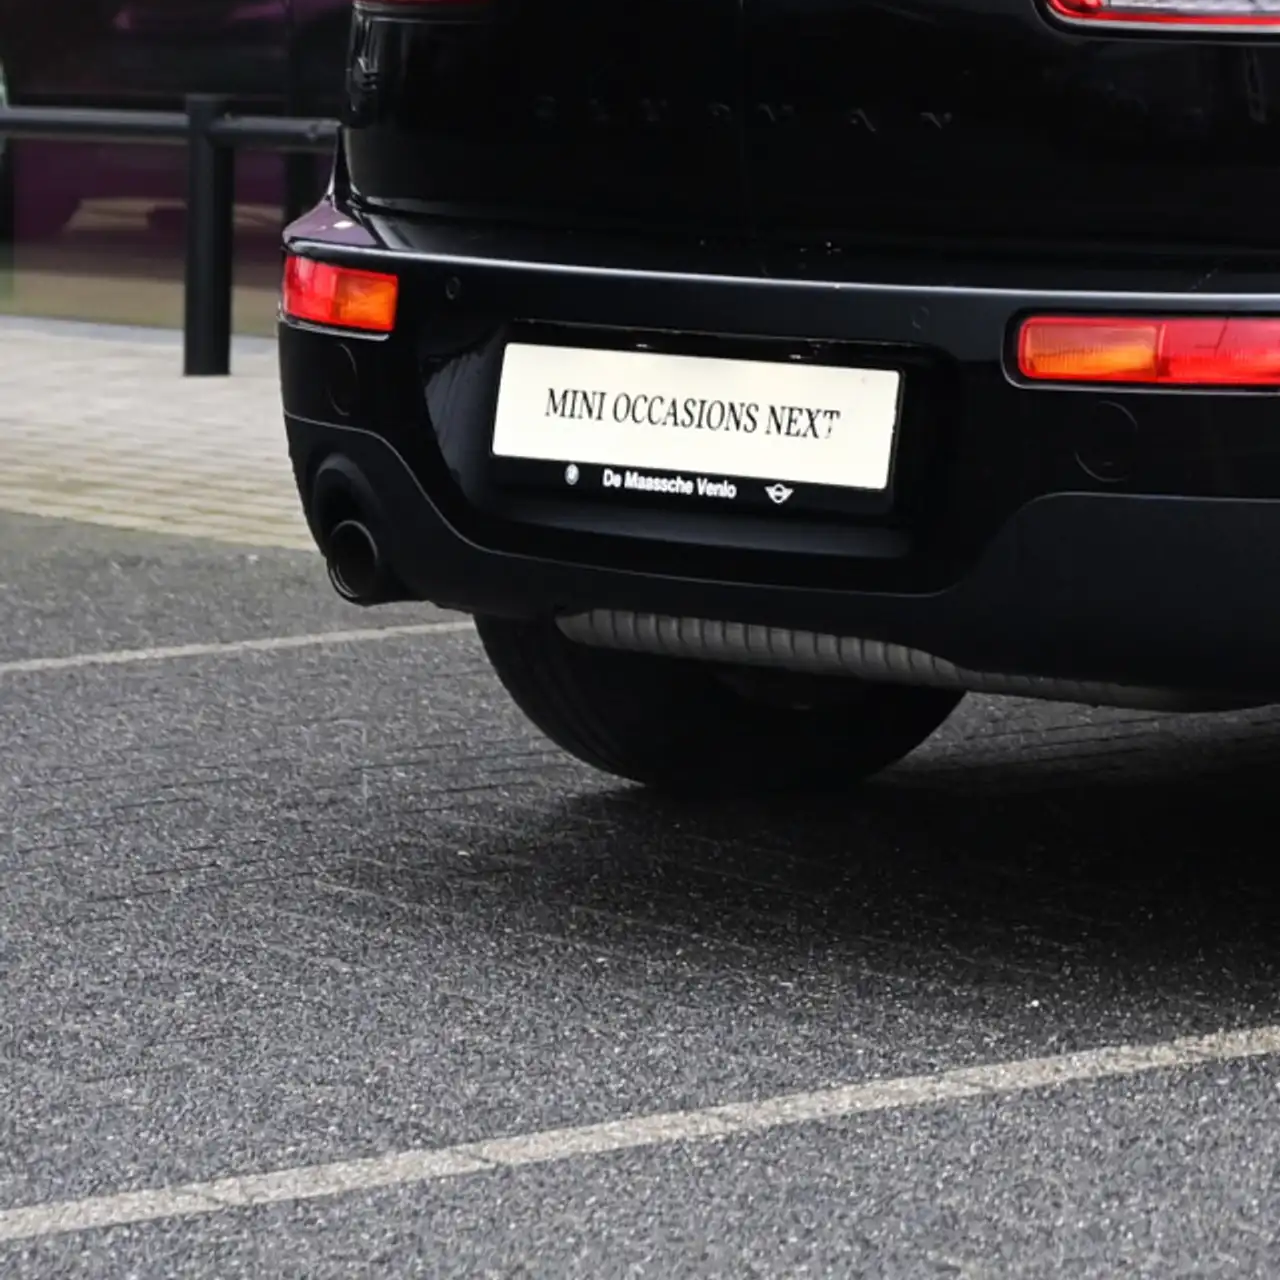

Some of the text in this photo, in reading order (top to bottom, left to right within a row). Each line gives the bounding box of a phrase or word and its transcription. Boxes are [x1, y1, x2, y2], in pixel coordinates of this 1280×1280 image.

[545, 387, 841, 439] MINI OCCASIONS NEXT
[602, 468, 737, 499] De Maassche Venlo
